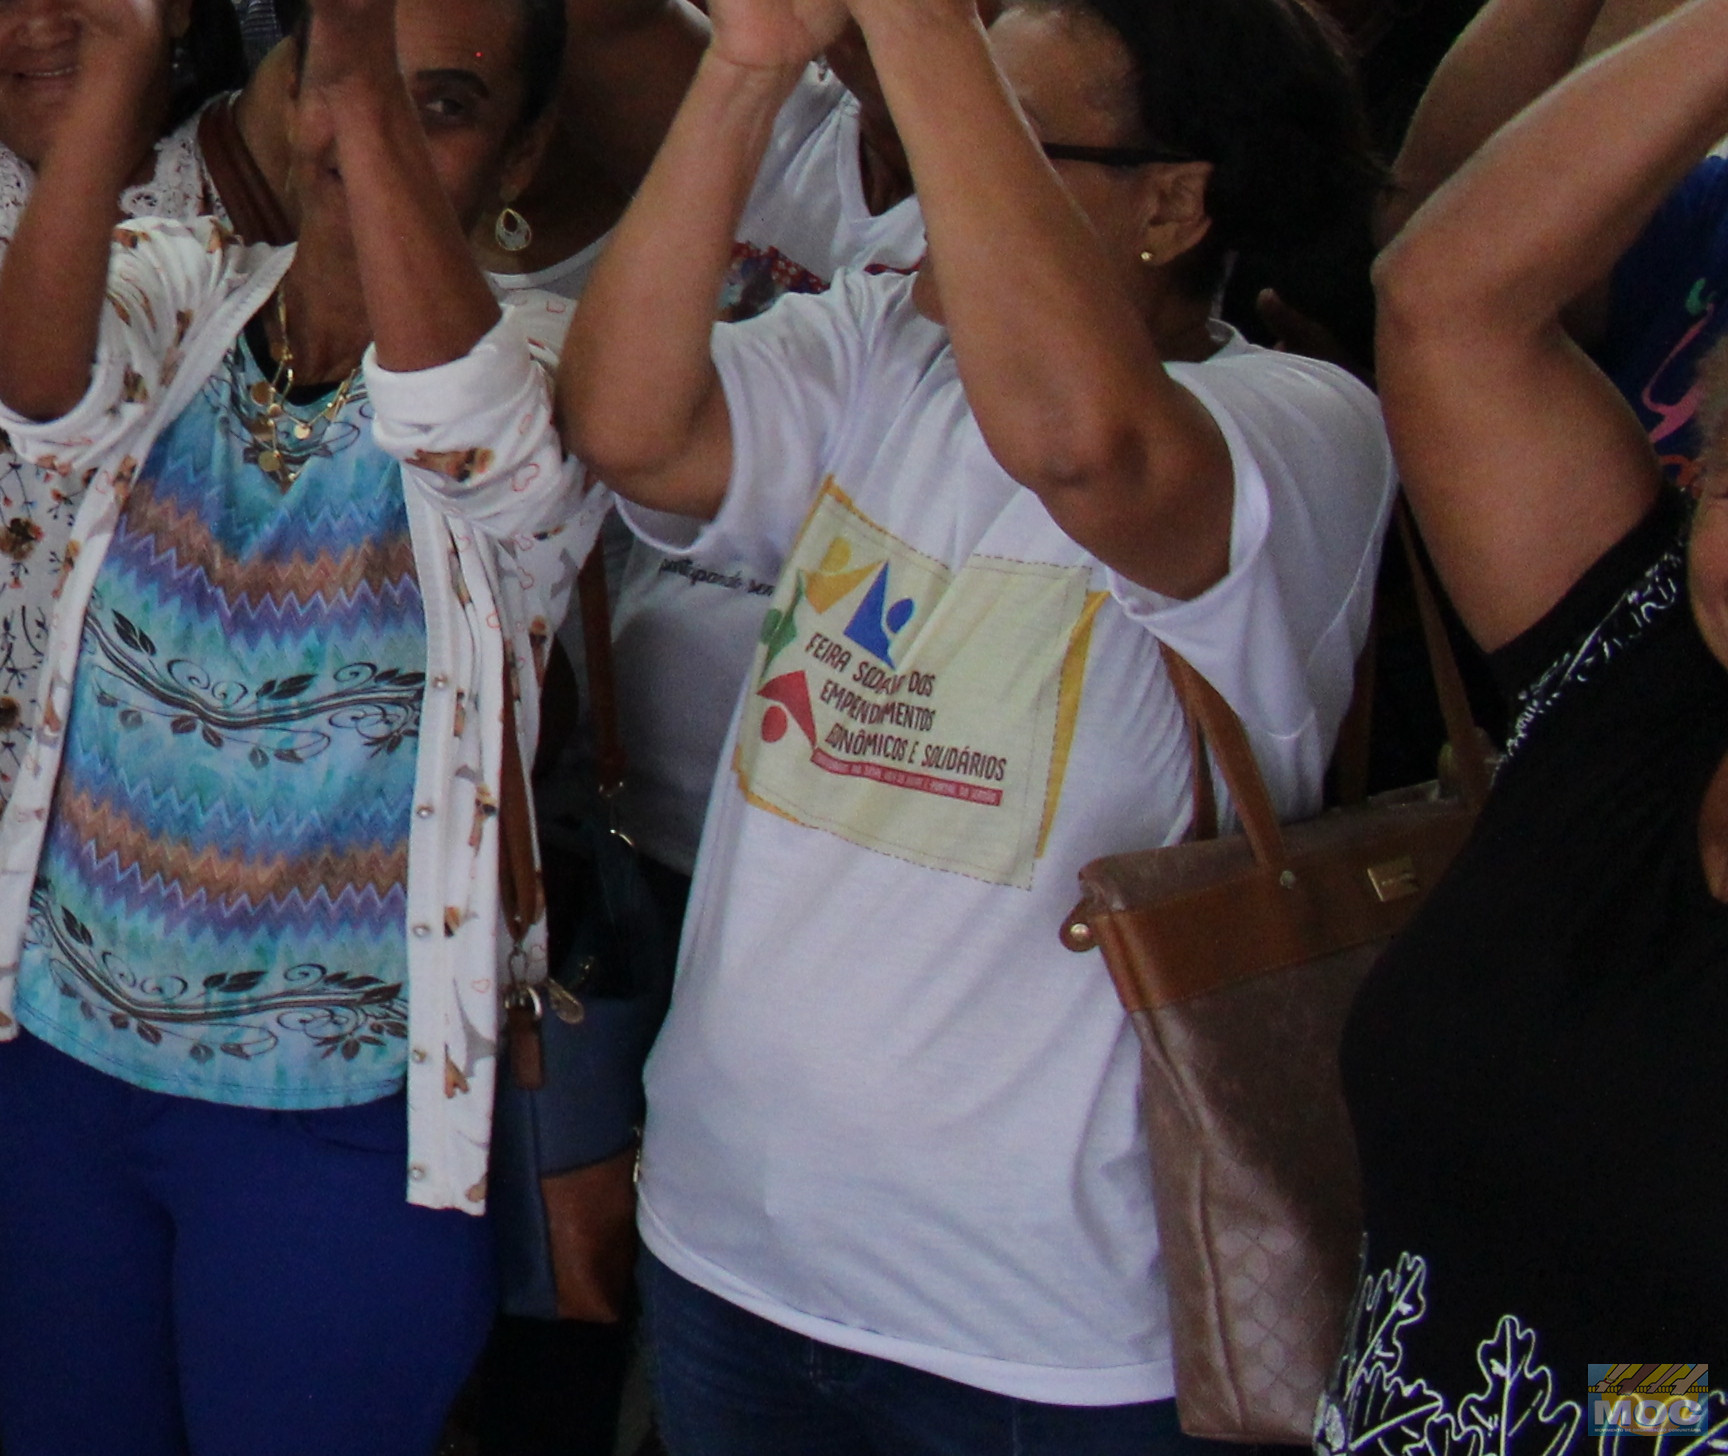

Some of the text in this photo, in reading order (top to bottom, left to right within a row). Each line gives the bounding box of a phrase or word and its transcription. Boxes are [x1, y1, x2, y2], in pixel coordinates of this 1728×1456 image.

[805, 632, 853, 673] FEIRA
[907, 670, 936, 698] DOS
[908, 740, 920, 764] E
[920, 743, 1008, 782] SOLIDÁRIOS
